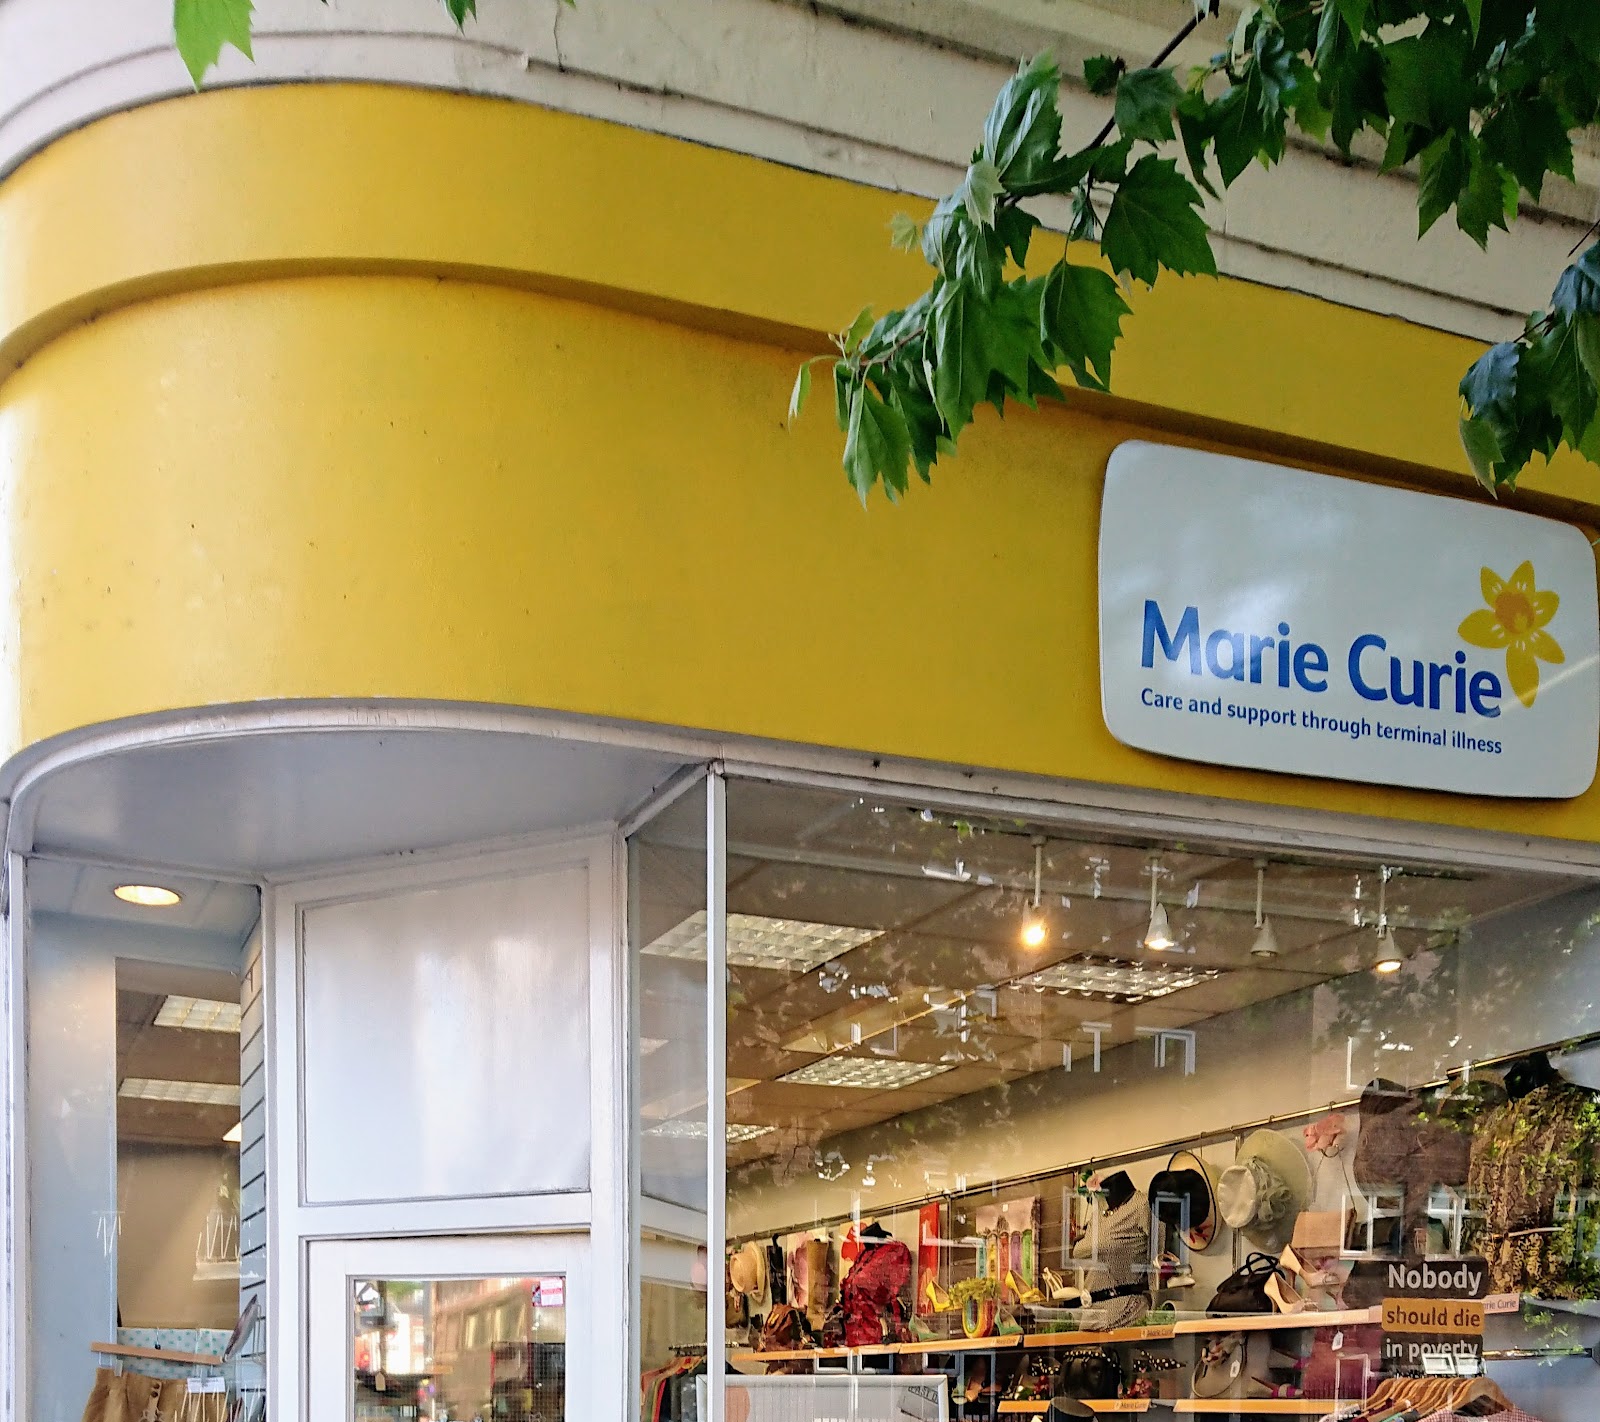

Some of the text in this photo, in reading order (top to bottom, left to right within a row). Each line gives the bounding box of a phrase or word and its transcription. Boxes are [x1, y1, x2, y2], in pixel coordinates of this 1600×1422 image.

[1141, 599, 1502, 718] Marie Curie
[1141, 688, 1502, 754] Care and support through terminal illness
[1388, 1263, 1481, 1296] Nobody
[1387, 1305, 1480, 1327] should die
[1497, 1299, 1516, 1309] Curie
[1386, 1338, 1478, 1362] in poverty
